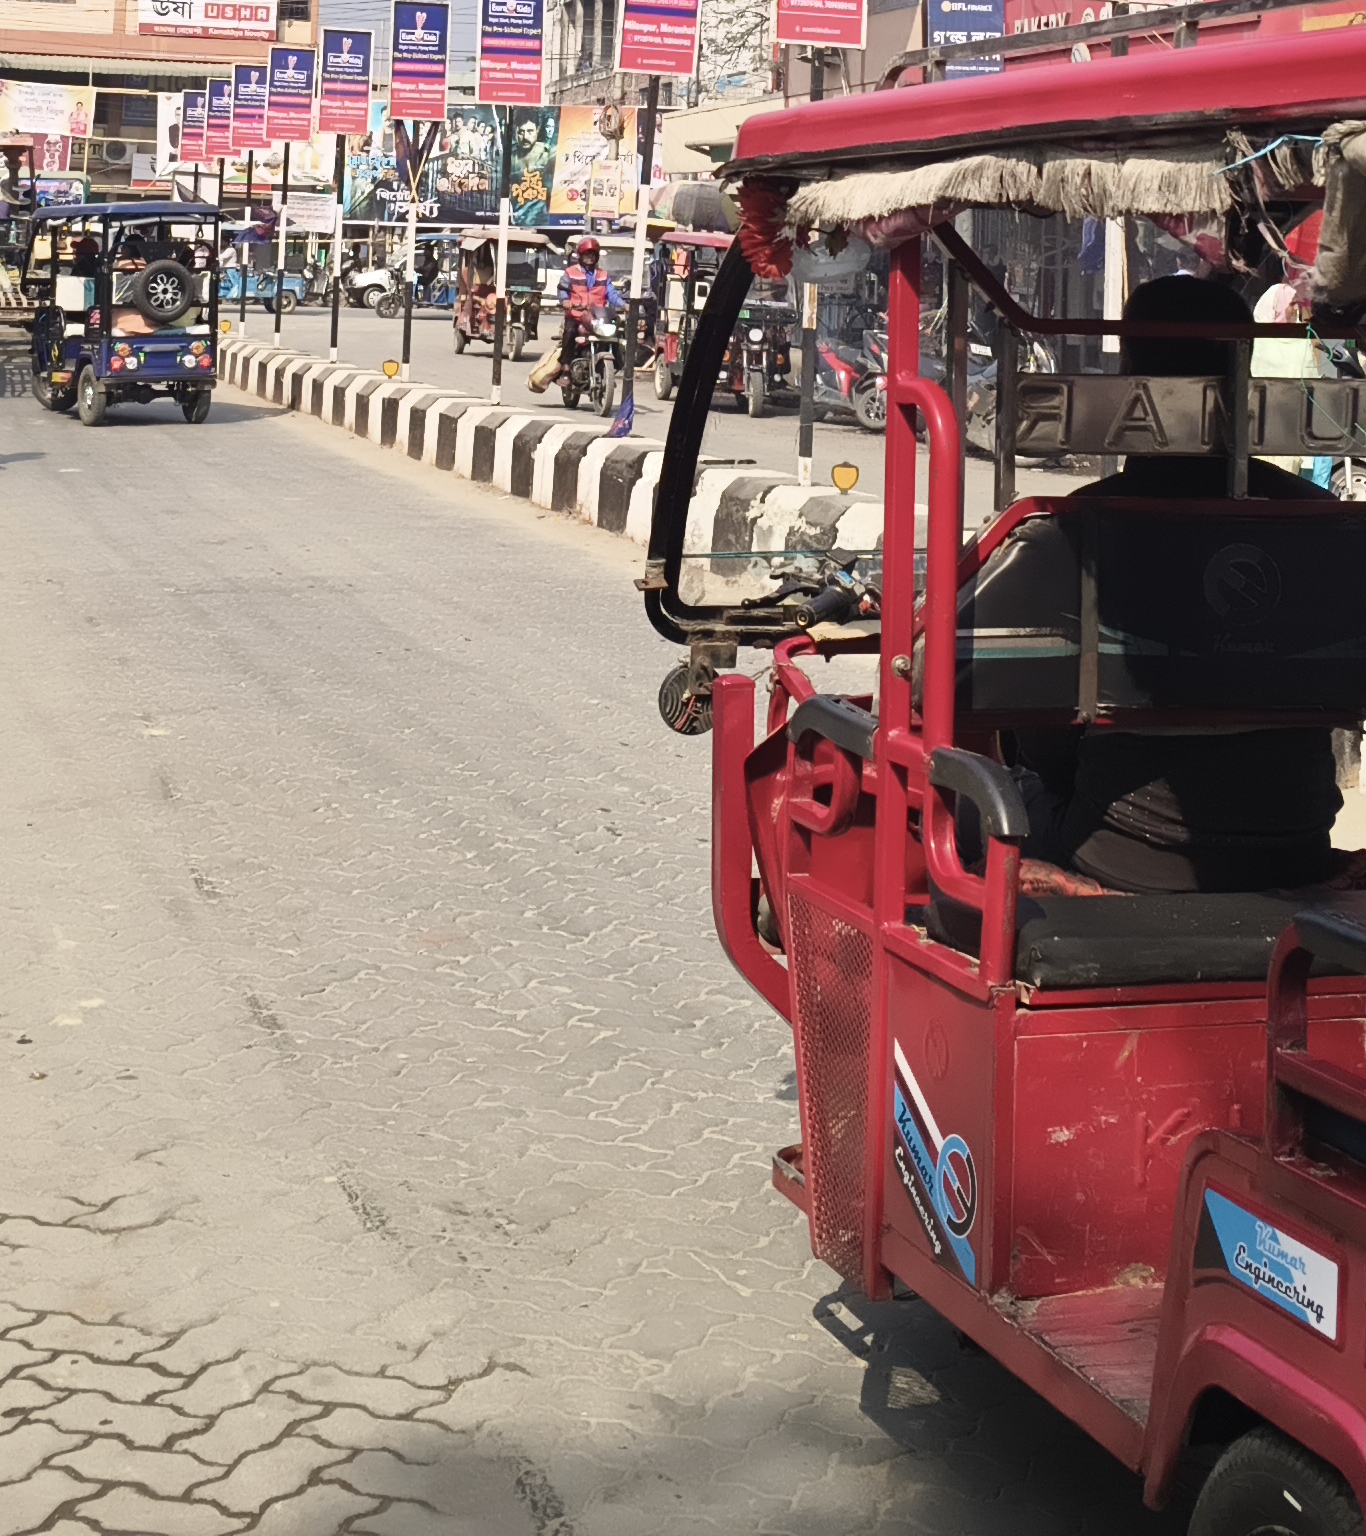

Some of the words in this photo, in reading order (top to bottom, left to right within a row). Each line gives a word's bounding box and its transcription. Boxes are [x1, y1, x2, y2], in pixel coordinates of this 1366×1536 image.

[206, 5, 268, 20] USHA
[897, 1100, 937, 1197] Kumar
[895, 1145, 943, 1255] Engineering
[1234, 1244, 1326, 1323] Engineering
[1254, 1220, 1309, 1276] Kumar
